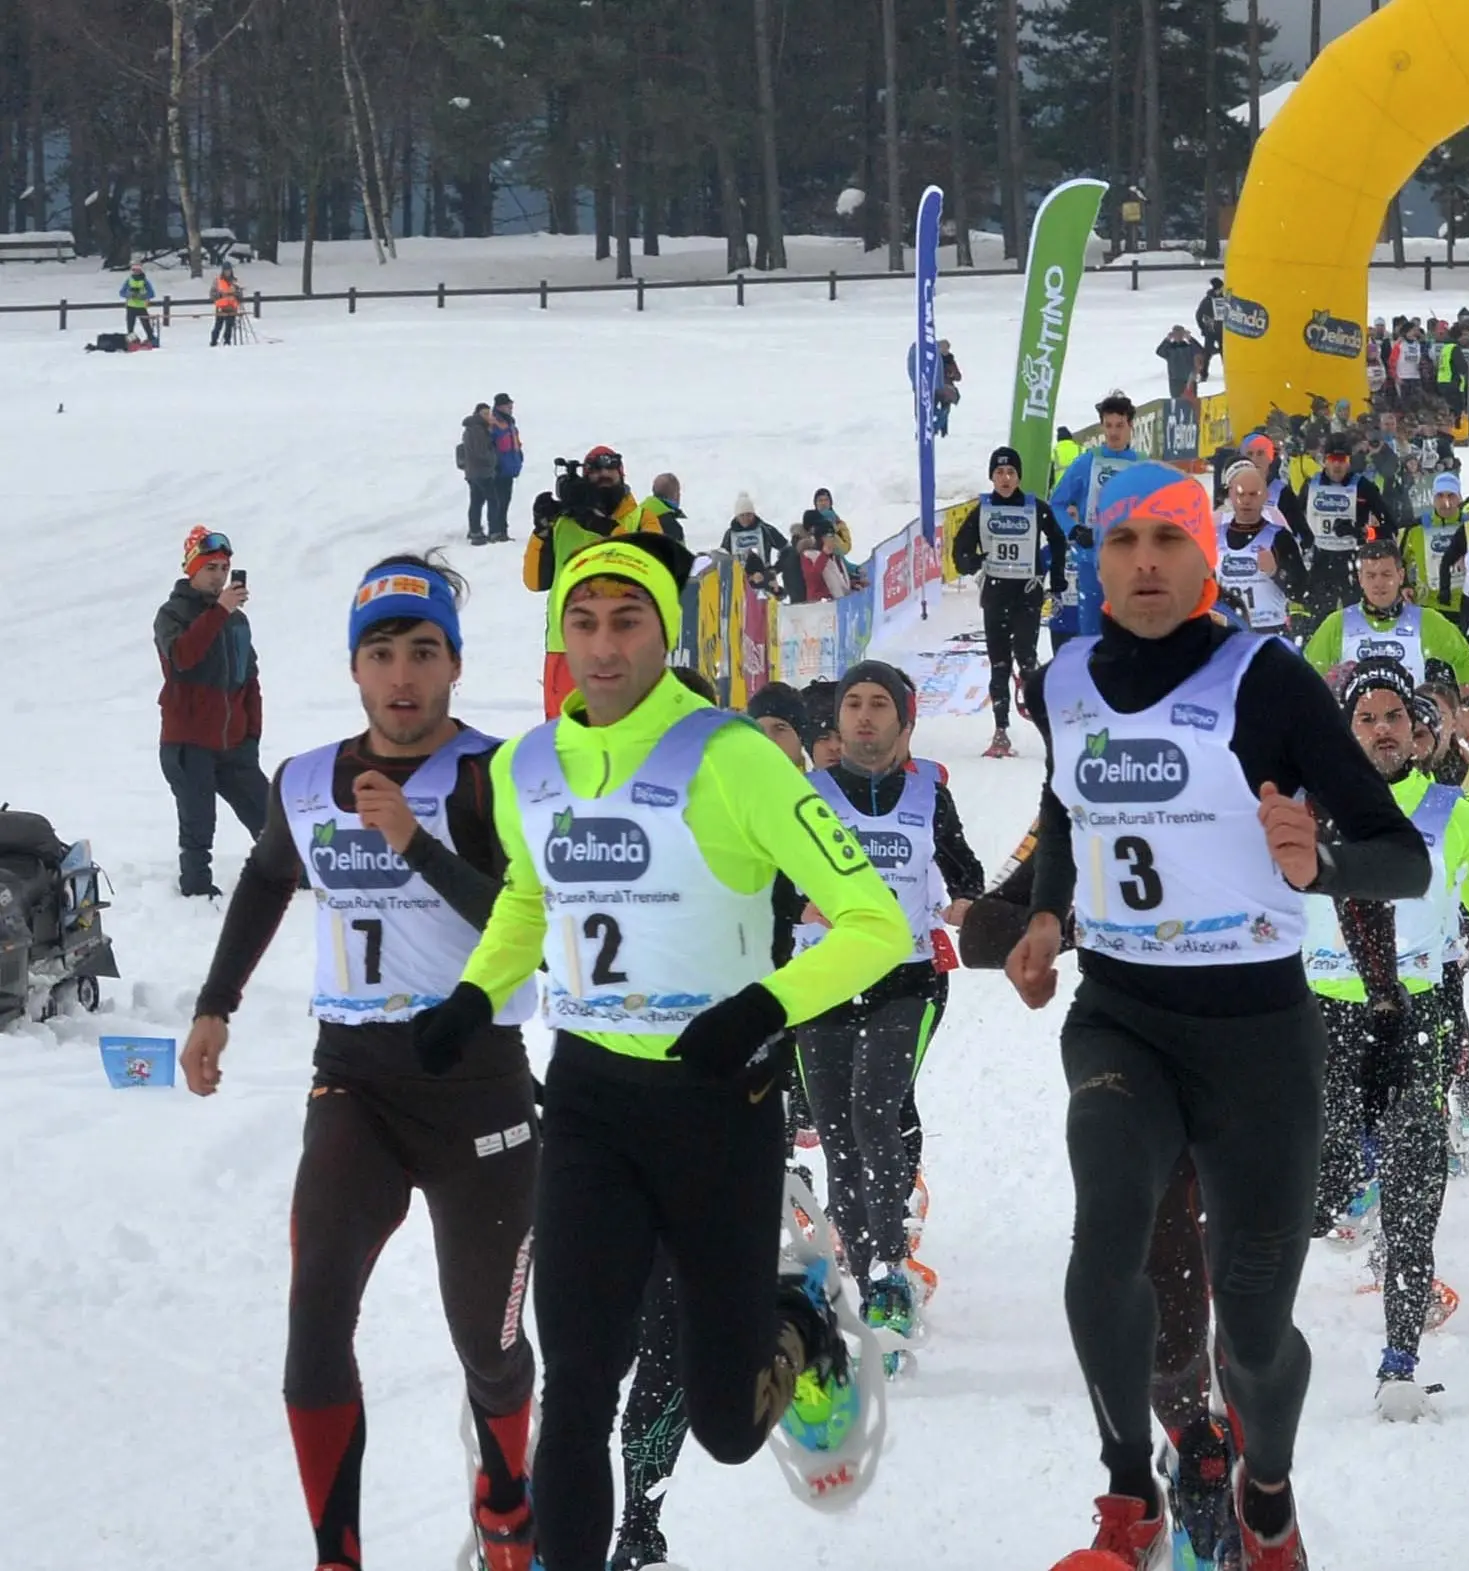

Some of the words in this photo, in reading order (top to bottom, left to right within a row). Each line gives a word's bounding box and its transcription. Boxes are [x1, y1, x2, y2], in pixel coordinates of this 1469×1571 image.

[1021, 264, 1066, 422] TRENTINO
[1306, 322, 1362, 351] Melinda
[997, 543, 1020, 561] 99
[1078, 751, 1182, 784] Melinda
[1118, 810, 1155, 826] Rurali
[1156, 809, 1216, 825] Trentine
[547, 831, 645, 865] Melinda
[862, 837, 909, 859] elinda
[1113, 835, 1164, 912] 3
[388, 895, 441, 910] Trentine
[623, 889, 681, 904] Trentine
[351, 918, 383, 985] 7
[582, 912, 629, 986] 2
